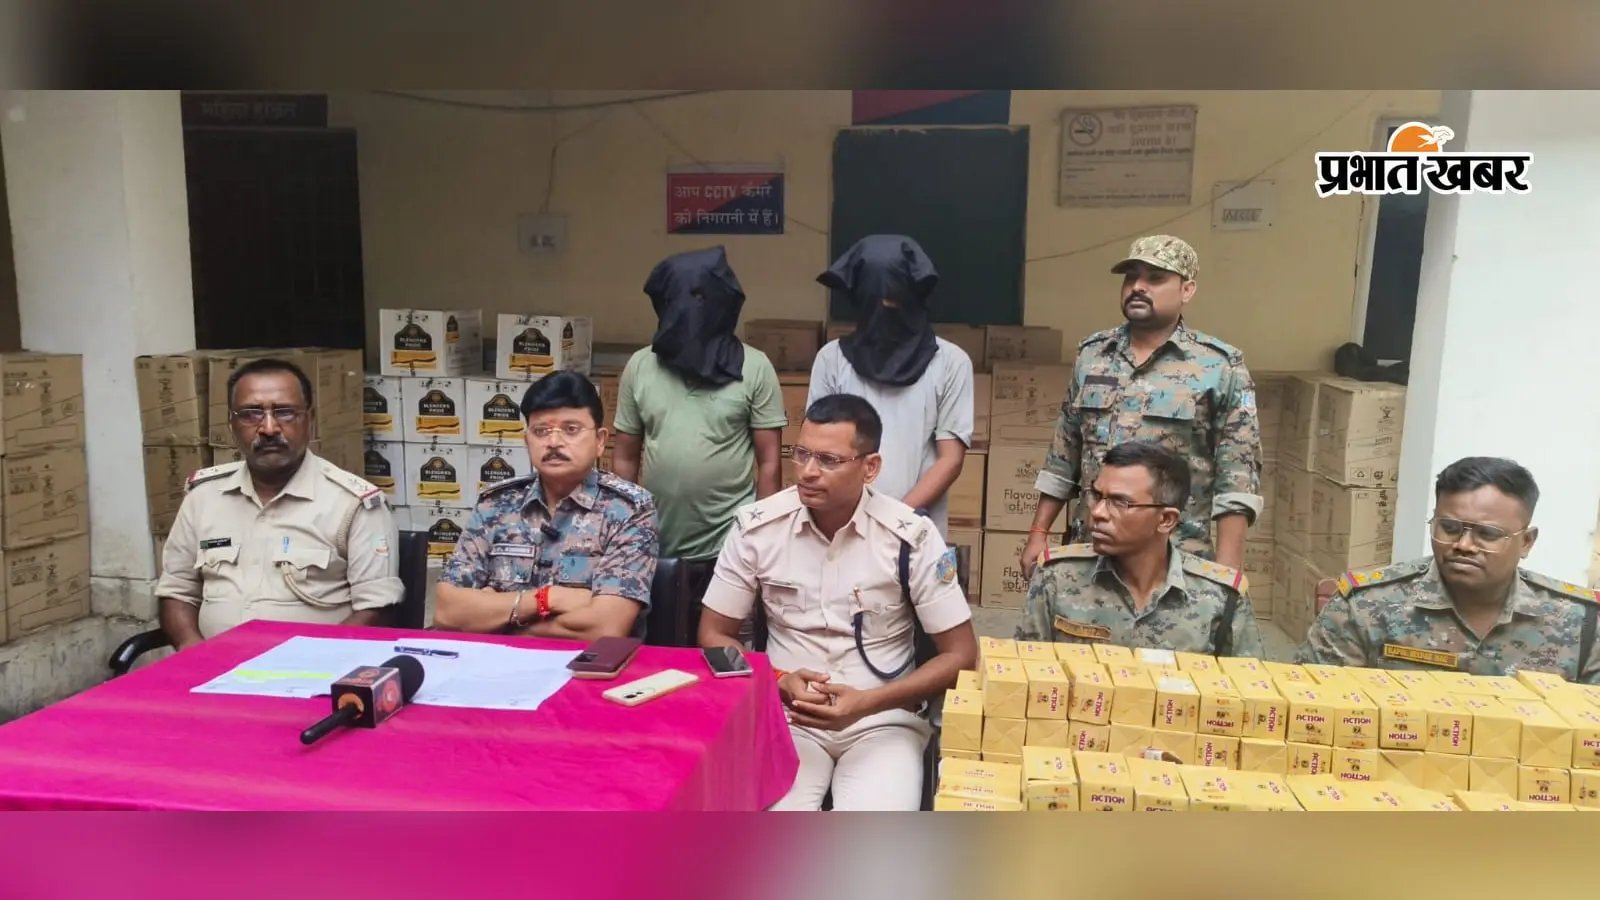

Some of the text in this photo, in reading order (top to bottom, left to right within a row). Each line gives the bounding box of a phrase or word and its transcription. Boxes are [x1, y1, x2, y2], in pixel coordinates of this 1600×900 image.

[675, 186, 701, 198] आप
[705, 186, 737, 198] CCTV
[696, 208, 745, 224] निगरानी
[748, 208, 759, 226] में
[1004, 488, 1039, 500] Flavou
[1023, 502, 1037, 511] Ind
[1050, 687, 1058, 712] ACTION
[1095, 692, 1104, 717] ACTION
[1268, 706, 1277, 732] ACTION
[1296, 714, 1325, 723] ACTION
[1388, 733, 1418, 741] ACTION
[1452, 720, 1460, 747] ACTION
[1584, 740, 1600, 748] ACT
[1311, 753, 1320, 775] ACTIO
[1341, 772, 1370, 781] ACTION
[1091, 794, 1125, 804] ACTION
[1528, 794, 1560, 802] ACTION
